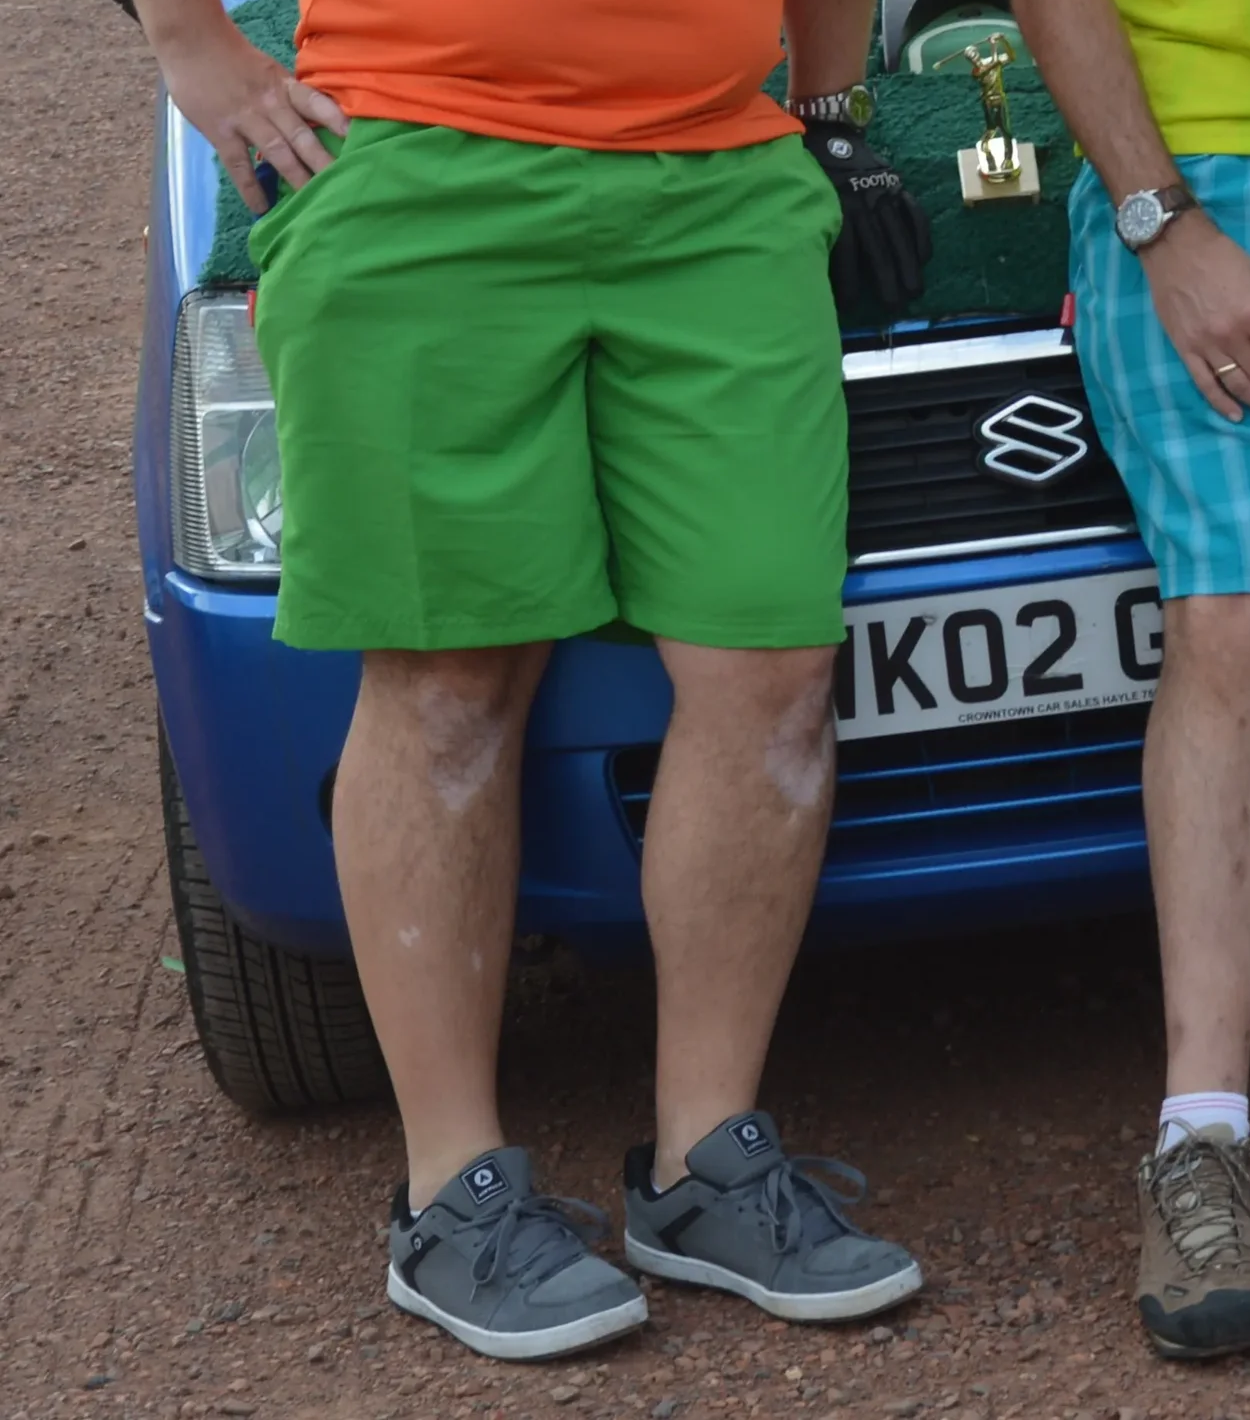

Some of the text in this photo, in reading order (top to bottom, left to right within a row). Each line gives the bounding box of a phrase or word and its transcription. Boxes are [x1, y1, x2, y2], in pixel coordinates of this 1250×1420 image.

[957, 704, 1035, 724] CROWNTOWN
[1036, 701, 1061, 714] CAR
[1063, 695, 1100, 710] SALES
[1102, 691, 1140, 705] HAYLE
